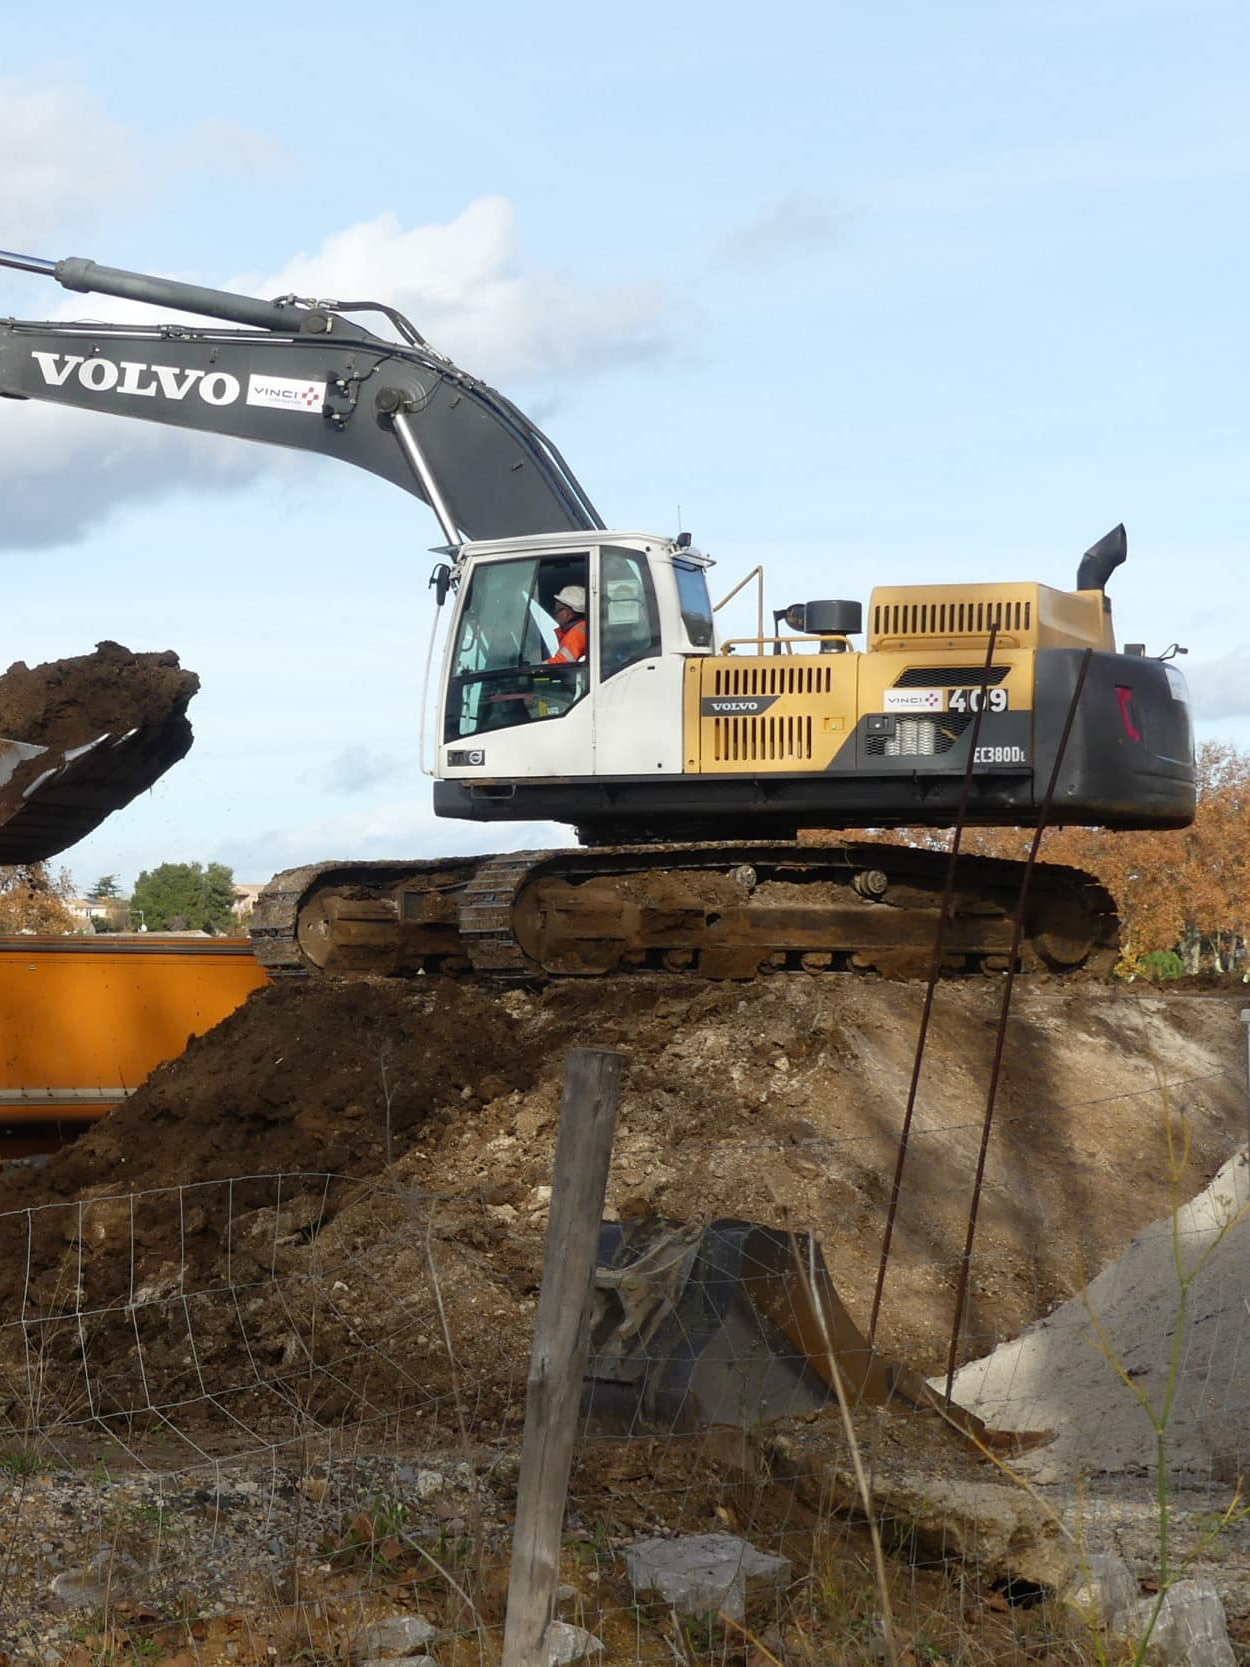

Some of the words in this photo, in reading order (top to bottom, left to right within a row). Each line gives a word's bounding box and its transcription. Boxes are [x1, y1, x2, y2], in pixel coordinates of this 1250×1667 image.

[31, 351, 241, 406] VOLVO
[254, 387, 298, 399] VINCI
[711, 702, 758, 711] VOLVO
[949, 689, 1007, 712] 409
